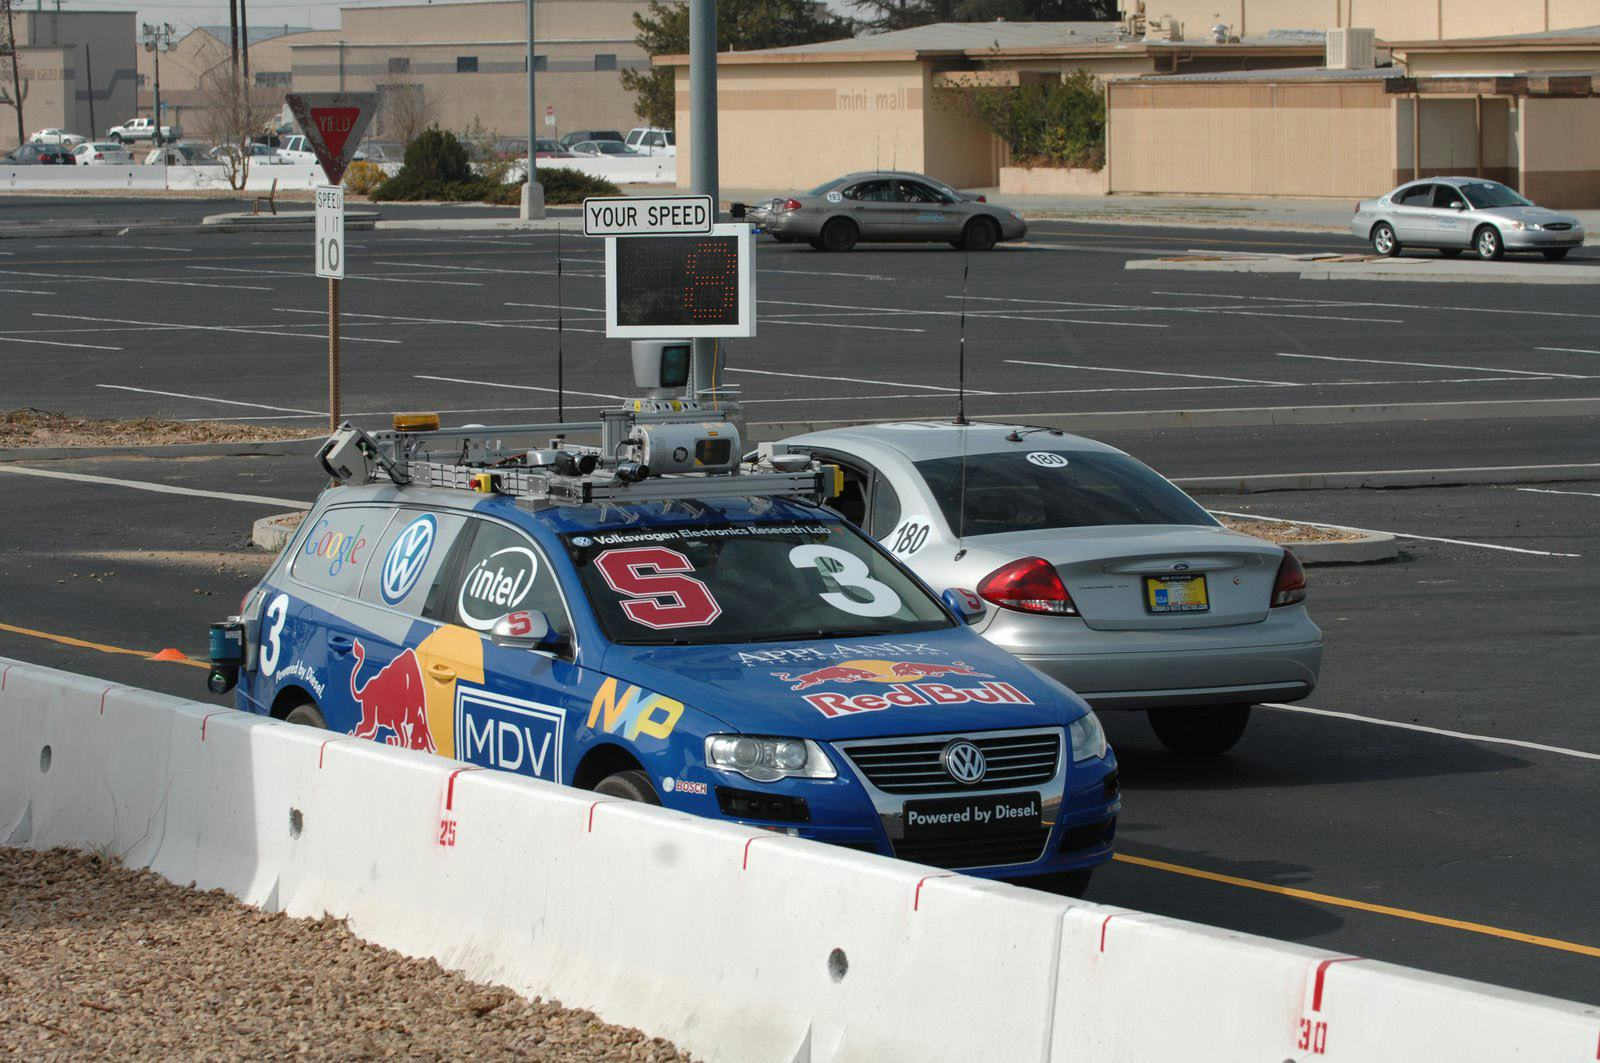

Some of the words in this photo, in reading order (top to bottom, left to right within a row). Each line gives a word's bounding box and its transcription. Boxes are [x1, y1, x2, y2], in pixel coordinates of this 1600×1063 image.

[840, 87, 867, 110] mini
[876, 87, 905, 110] mall
[317, 191, 341, 209] SPEED
[590, 206, 638, 227] YOUR
[647, 205, 706, 226] SPEED
[319, 237, 340, 272] 10
[1030, 453, 1065, 466] 180
[305, 519, 367, 577] Google
[593, 530, 681, 546] Volkswagen
[678, 526, 750, 538] Electronics
[747, 525, 807, 535] Research
[806, 525, 832, 534] Lab
[891, 522, 930, 555] 180
[469, 558, 526, 607] intel
[593, 545, 723, 630] S
[789, 544, 902, 617] 3
[260, 593, 290, 677] 3
[586, 676, 685, 742] NXP
[802, 684, 932, 718] Red
[912, 681, 1035, 705] Bull
[465, 712, 553, 777] MDV
[675, 778, 708, 795] BOSCH
[907, 806, 971, 826] Powered
[973, 805, 992, 824] by
[995, 801, 1039, 819] Diesel.
[439, 820, 457, 847] 25
[1297, 1018, 1328, 1055] 30
